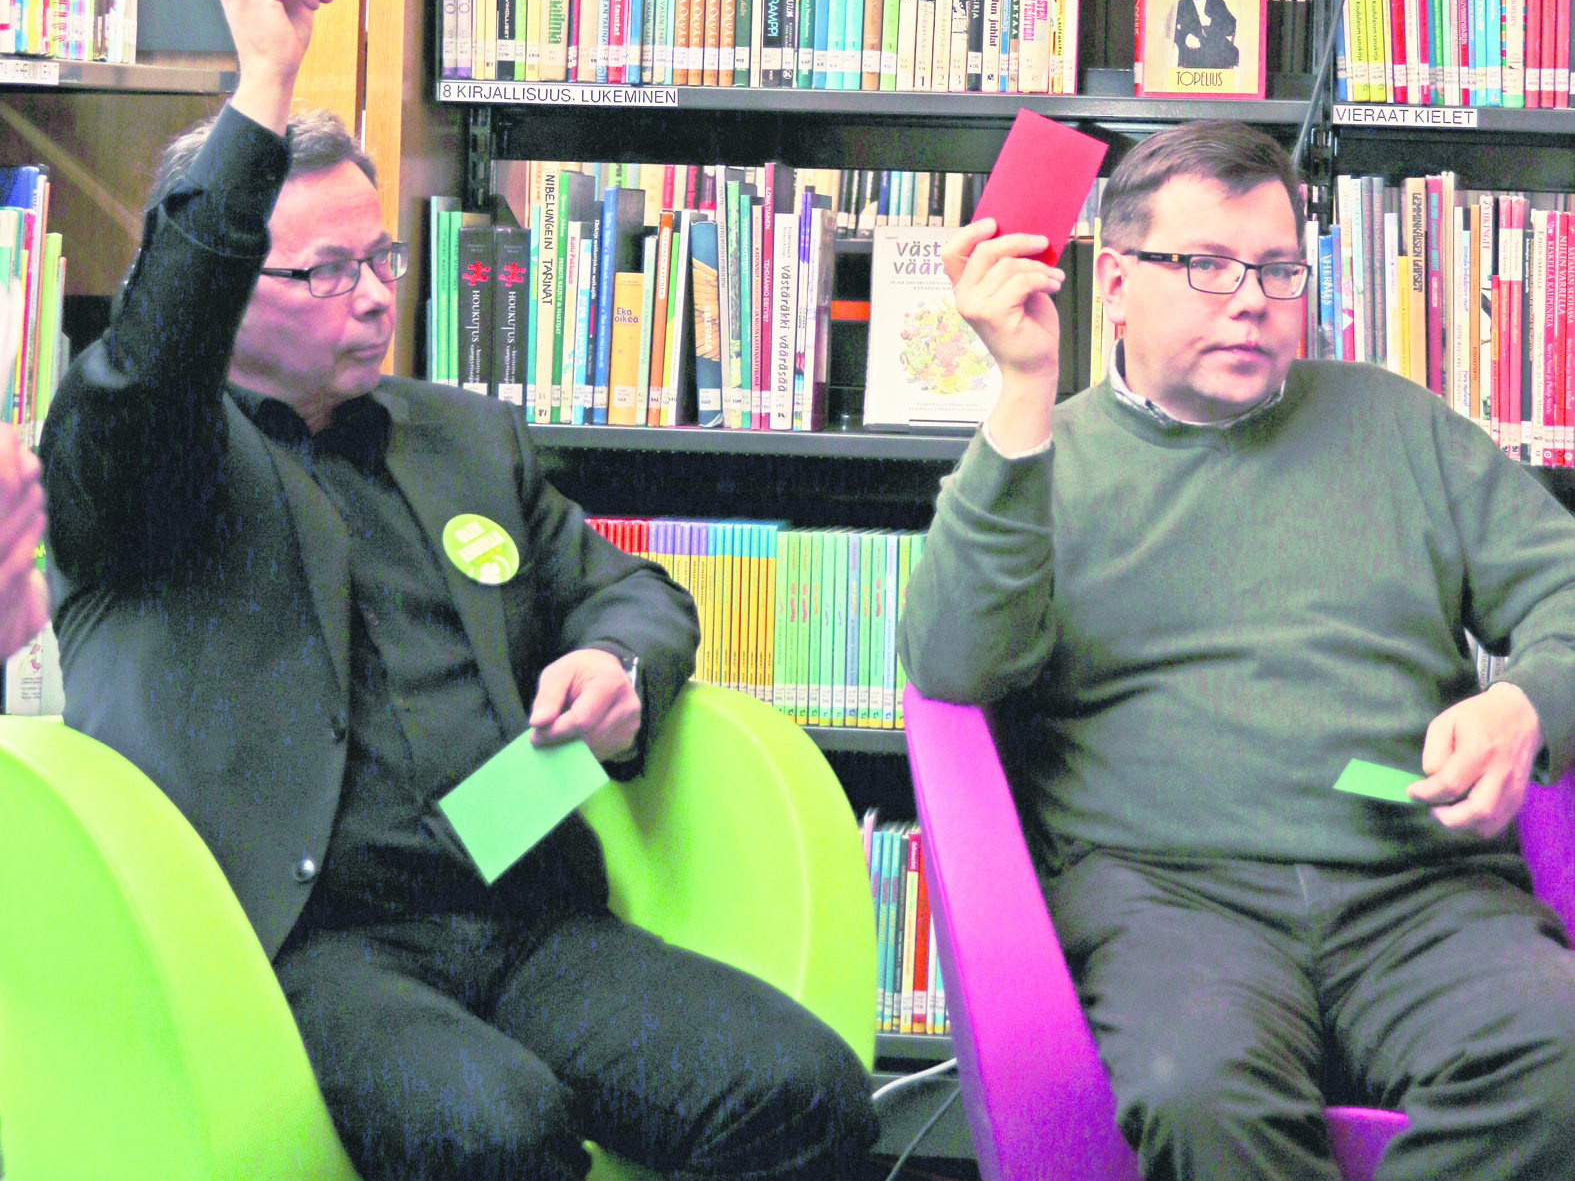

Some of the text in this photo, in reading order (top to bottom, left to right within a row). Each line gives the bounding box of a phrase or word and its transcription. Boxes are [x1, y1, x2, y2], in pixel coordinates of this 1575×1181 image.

[601, 17, 609, 46] TARINA
[613, 4, 623, 36] taustat
[988, 18, 1000, 47] juhlat
[1023, 2, 1036, 41] TEATTERI
[1370, 0, 1378, 33] Koululaisen
[1371, 34, 1380, 61] sanakirja
[442, 85, 677, 104] 8 KIRJALLISUUS. LUKEMINEN
[937, 74, 946, 87] 2
[953, 75, 962, 87] 3
[1176, 71, 1223, 87] TOPELIUS
[1335, 107, 1474, 125] VIERAAT KIELET
[542, 174, 555, 306] NIBELUNGEIN TARINAT
[1412, 192, 1424, 293] LEMMINKÄISEN LAPSET
[1482, 206, 1490, 250] VIIKINGIT
[1536, 231, 1545, 254] KADUN
[896, 240, 942, 258] Väst
[1546, 240, 1555, 281] KESKELLÄ
[1566, 246, 1575, 283] SATAMAN
[556, 257, 565, 281] PEIKOT,
[568, 253, 576, 285] Pakkanen
[763, 260, 771, 297] TEHDÄÄNKÖ
[1321, 260, 1334, 306] HERMES
[1536, 255, 1544, 290] VARRELLA
[1558, 235, 1568, 315] NIILIN VARRELLA
[465, 290, 481, 343] HOUKUTUS
[501, 291, 517, 344] HOUKUTUS
[614, 315, 639, 324] oikea
[616, 307, 632, 316] Eka
[754, 310, 760, 318] JA
[1545, 281, 1555, 327] KAUPUNKIA
[1566, 284, 1575, 324] SUOJASSA
[703, 305, 713, 351] KALEVALA
[777, 265, 791, 393] Västäräkki vääräsää
